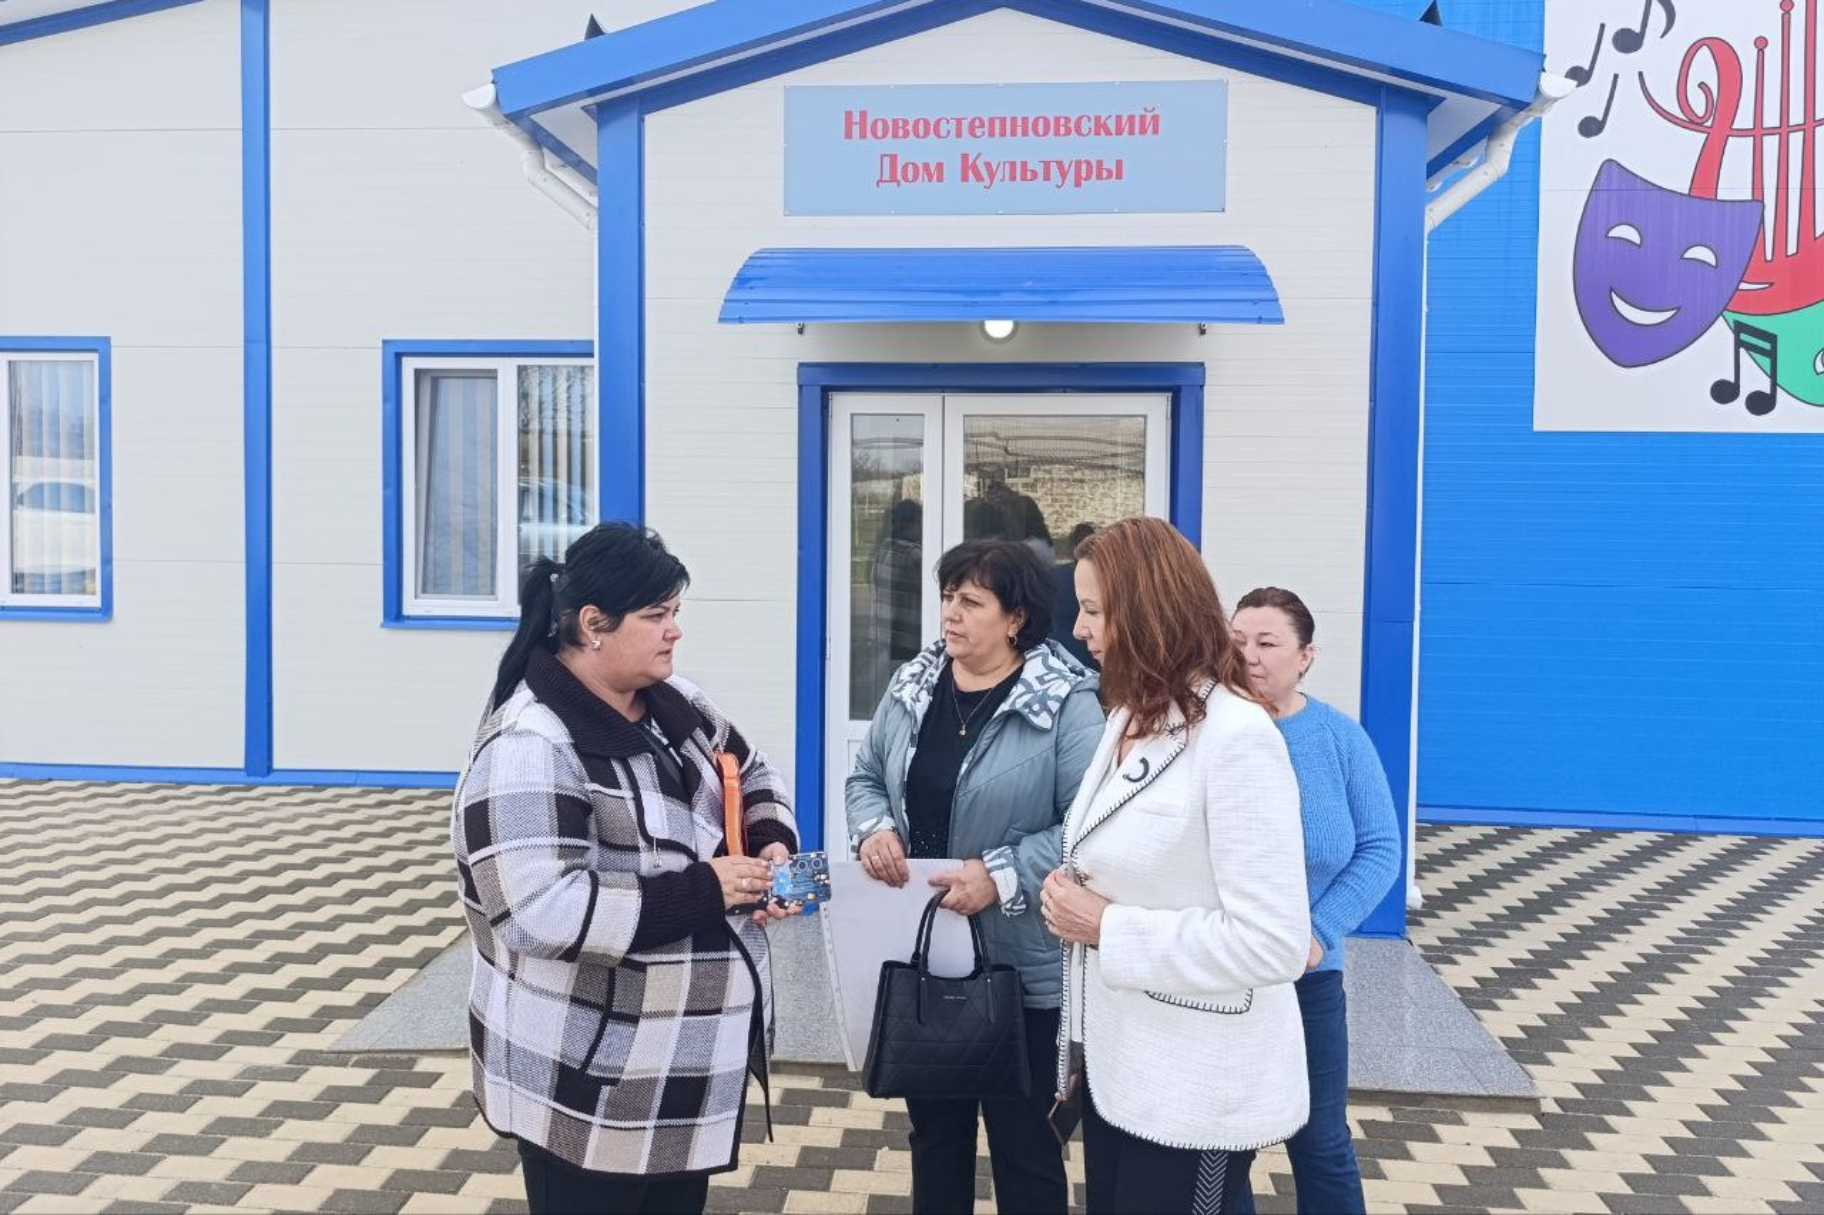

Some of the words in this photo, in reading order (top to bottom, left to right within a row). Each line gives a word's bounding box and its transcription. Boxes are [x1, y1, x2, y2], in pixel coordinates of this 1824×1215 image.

[843, 107, 1161, 140] Новостепновский
[876, 153, 945, 188] Дом
[959, 152, 1124, 189] Культуры
